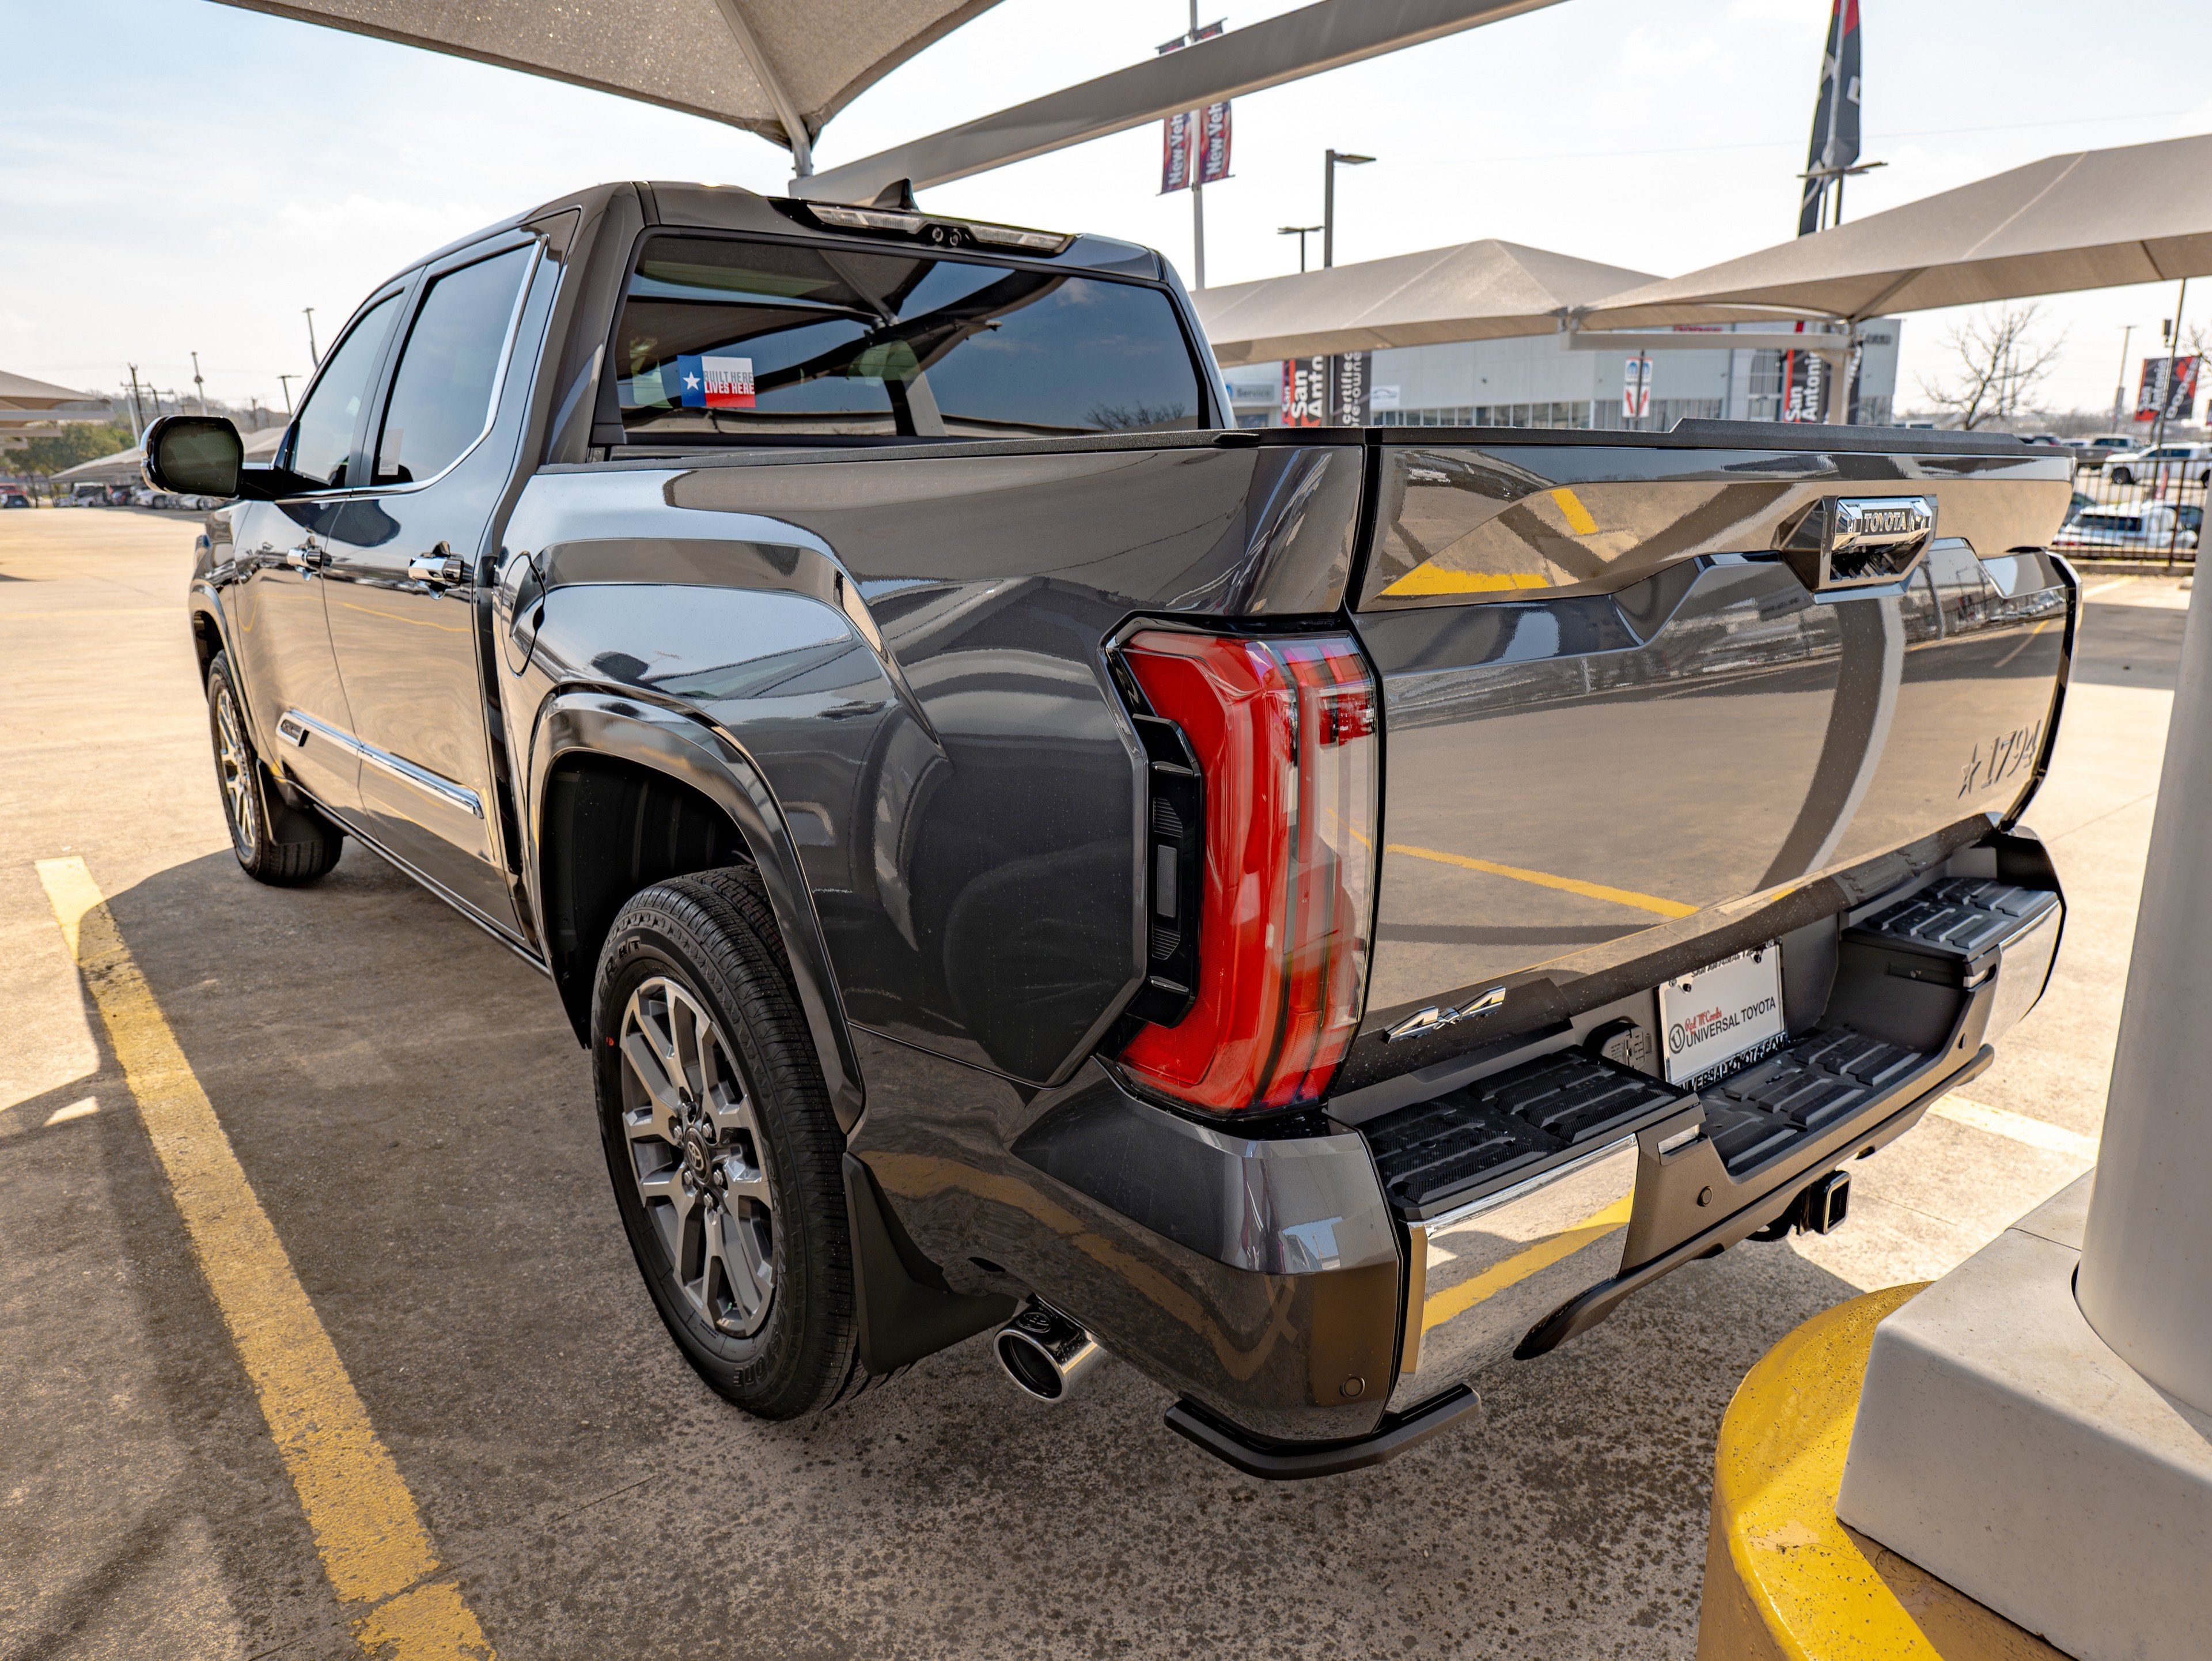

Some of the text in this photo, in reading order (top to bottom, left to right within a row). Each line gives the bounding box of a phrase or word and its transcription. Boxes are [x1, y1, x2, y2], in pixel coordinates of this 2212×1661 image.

[1168, 148, 1184, 186] New
[1206, 137, 1224, 175] New
[703, 370, 753, 383] BUILT HERE
[704, 381, 755, 395] LIVES HERE
[1290, 370, 1308, 419] San
[2149, 359, 2168, 411] Antonio
[2165, 357, 2200, 419] DODGE
[1785, 385, 1804, 422] San
[2137, 385, 2153, 413] San
[1864, 511, 1907, 533] TOYOTA
[1981, 719, 2041, 789] 1794
[1685, 996, 1776, 1047] UNIVERSAL TOYOTA
